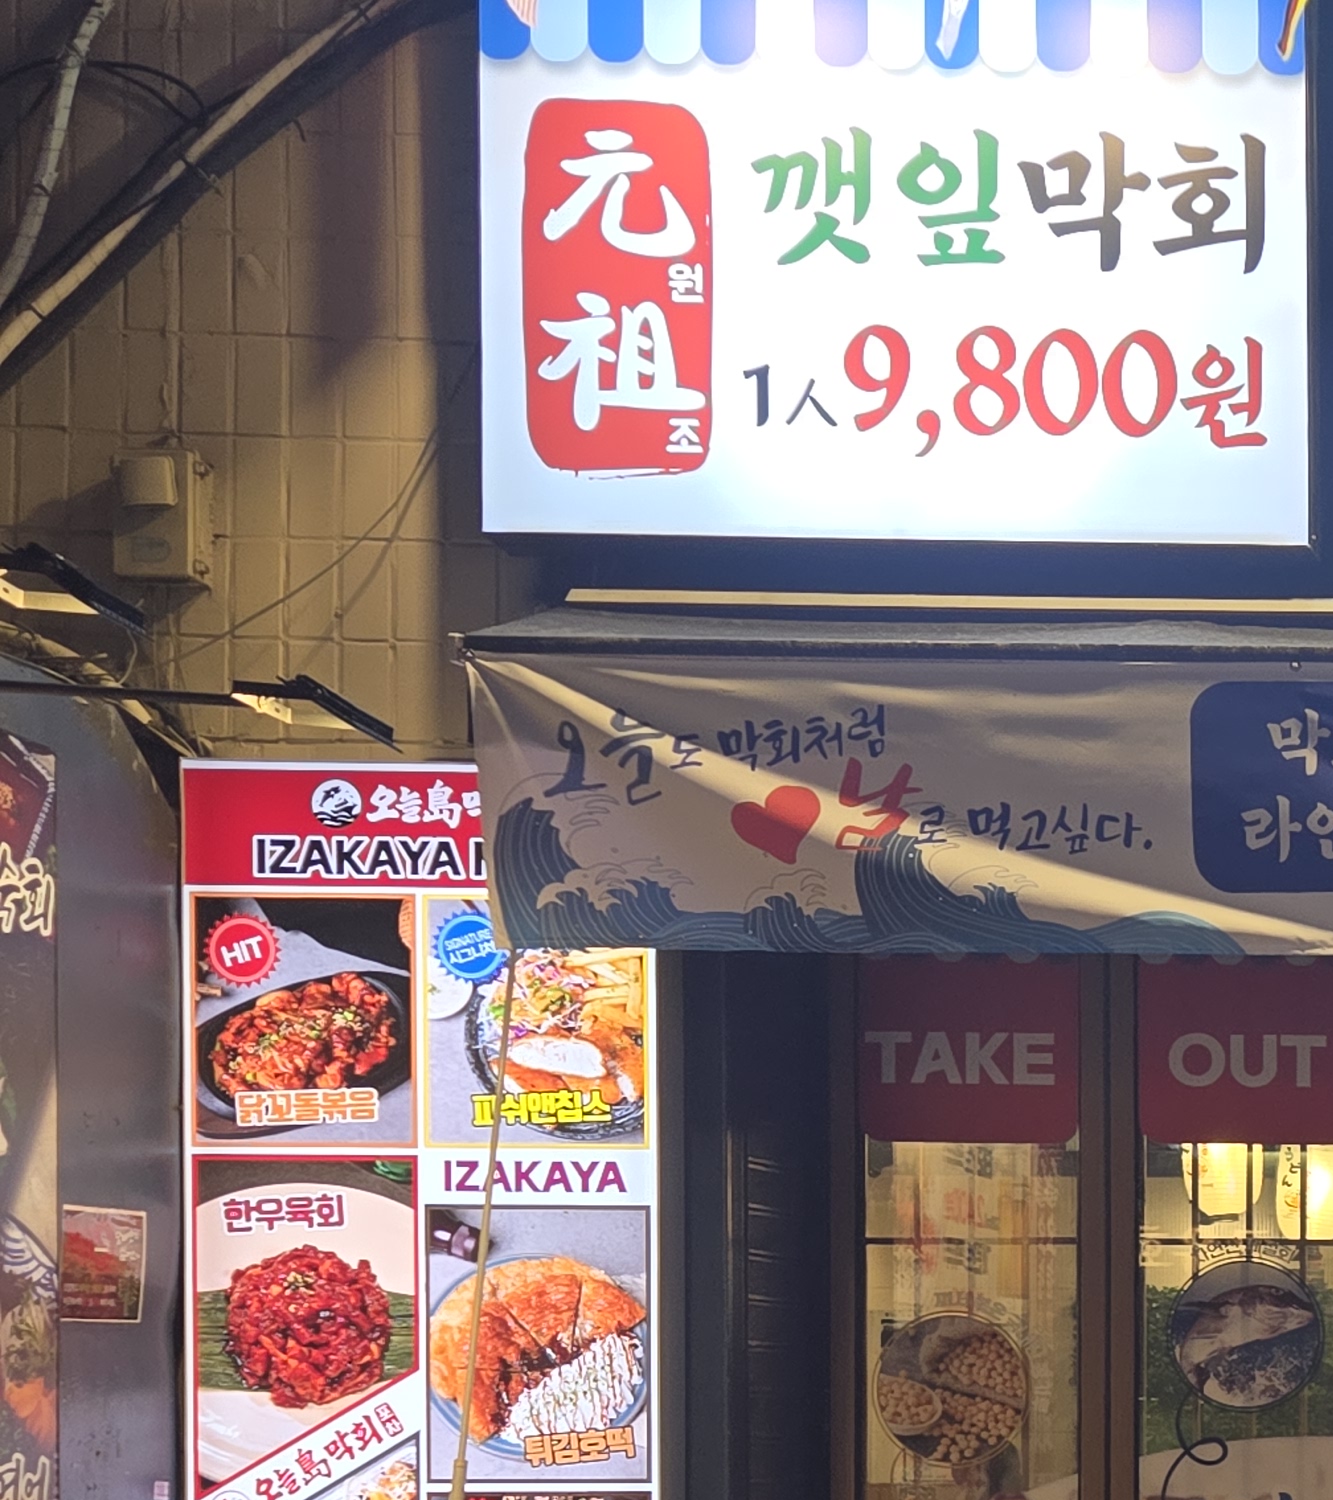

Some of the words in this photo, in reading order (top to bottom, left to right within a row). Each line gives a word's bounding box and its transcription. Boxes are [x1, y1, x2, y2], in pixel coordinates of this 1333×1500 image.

[751, 125, 1268, 275] 깻잎막회
[539, 129, 706, 430] 元祖
[843, 324, 1268, 457] 9,800원
[717, 704, 888, 771] 막회처럼
[255, 837, 461, 878] IZAKAYA
[221, 936, 263, 967] HIT
[864, 1031, 1056, 1086] TAKE
[1168, 1033, 1328, 1088] OUT
[443, 1160, 627, 1193] IZAKAYA
[223, 1194, 345, 1232] 한우육회
[524, 1428, 635, 1466] 튀김호떡
